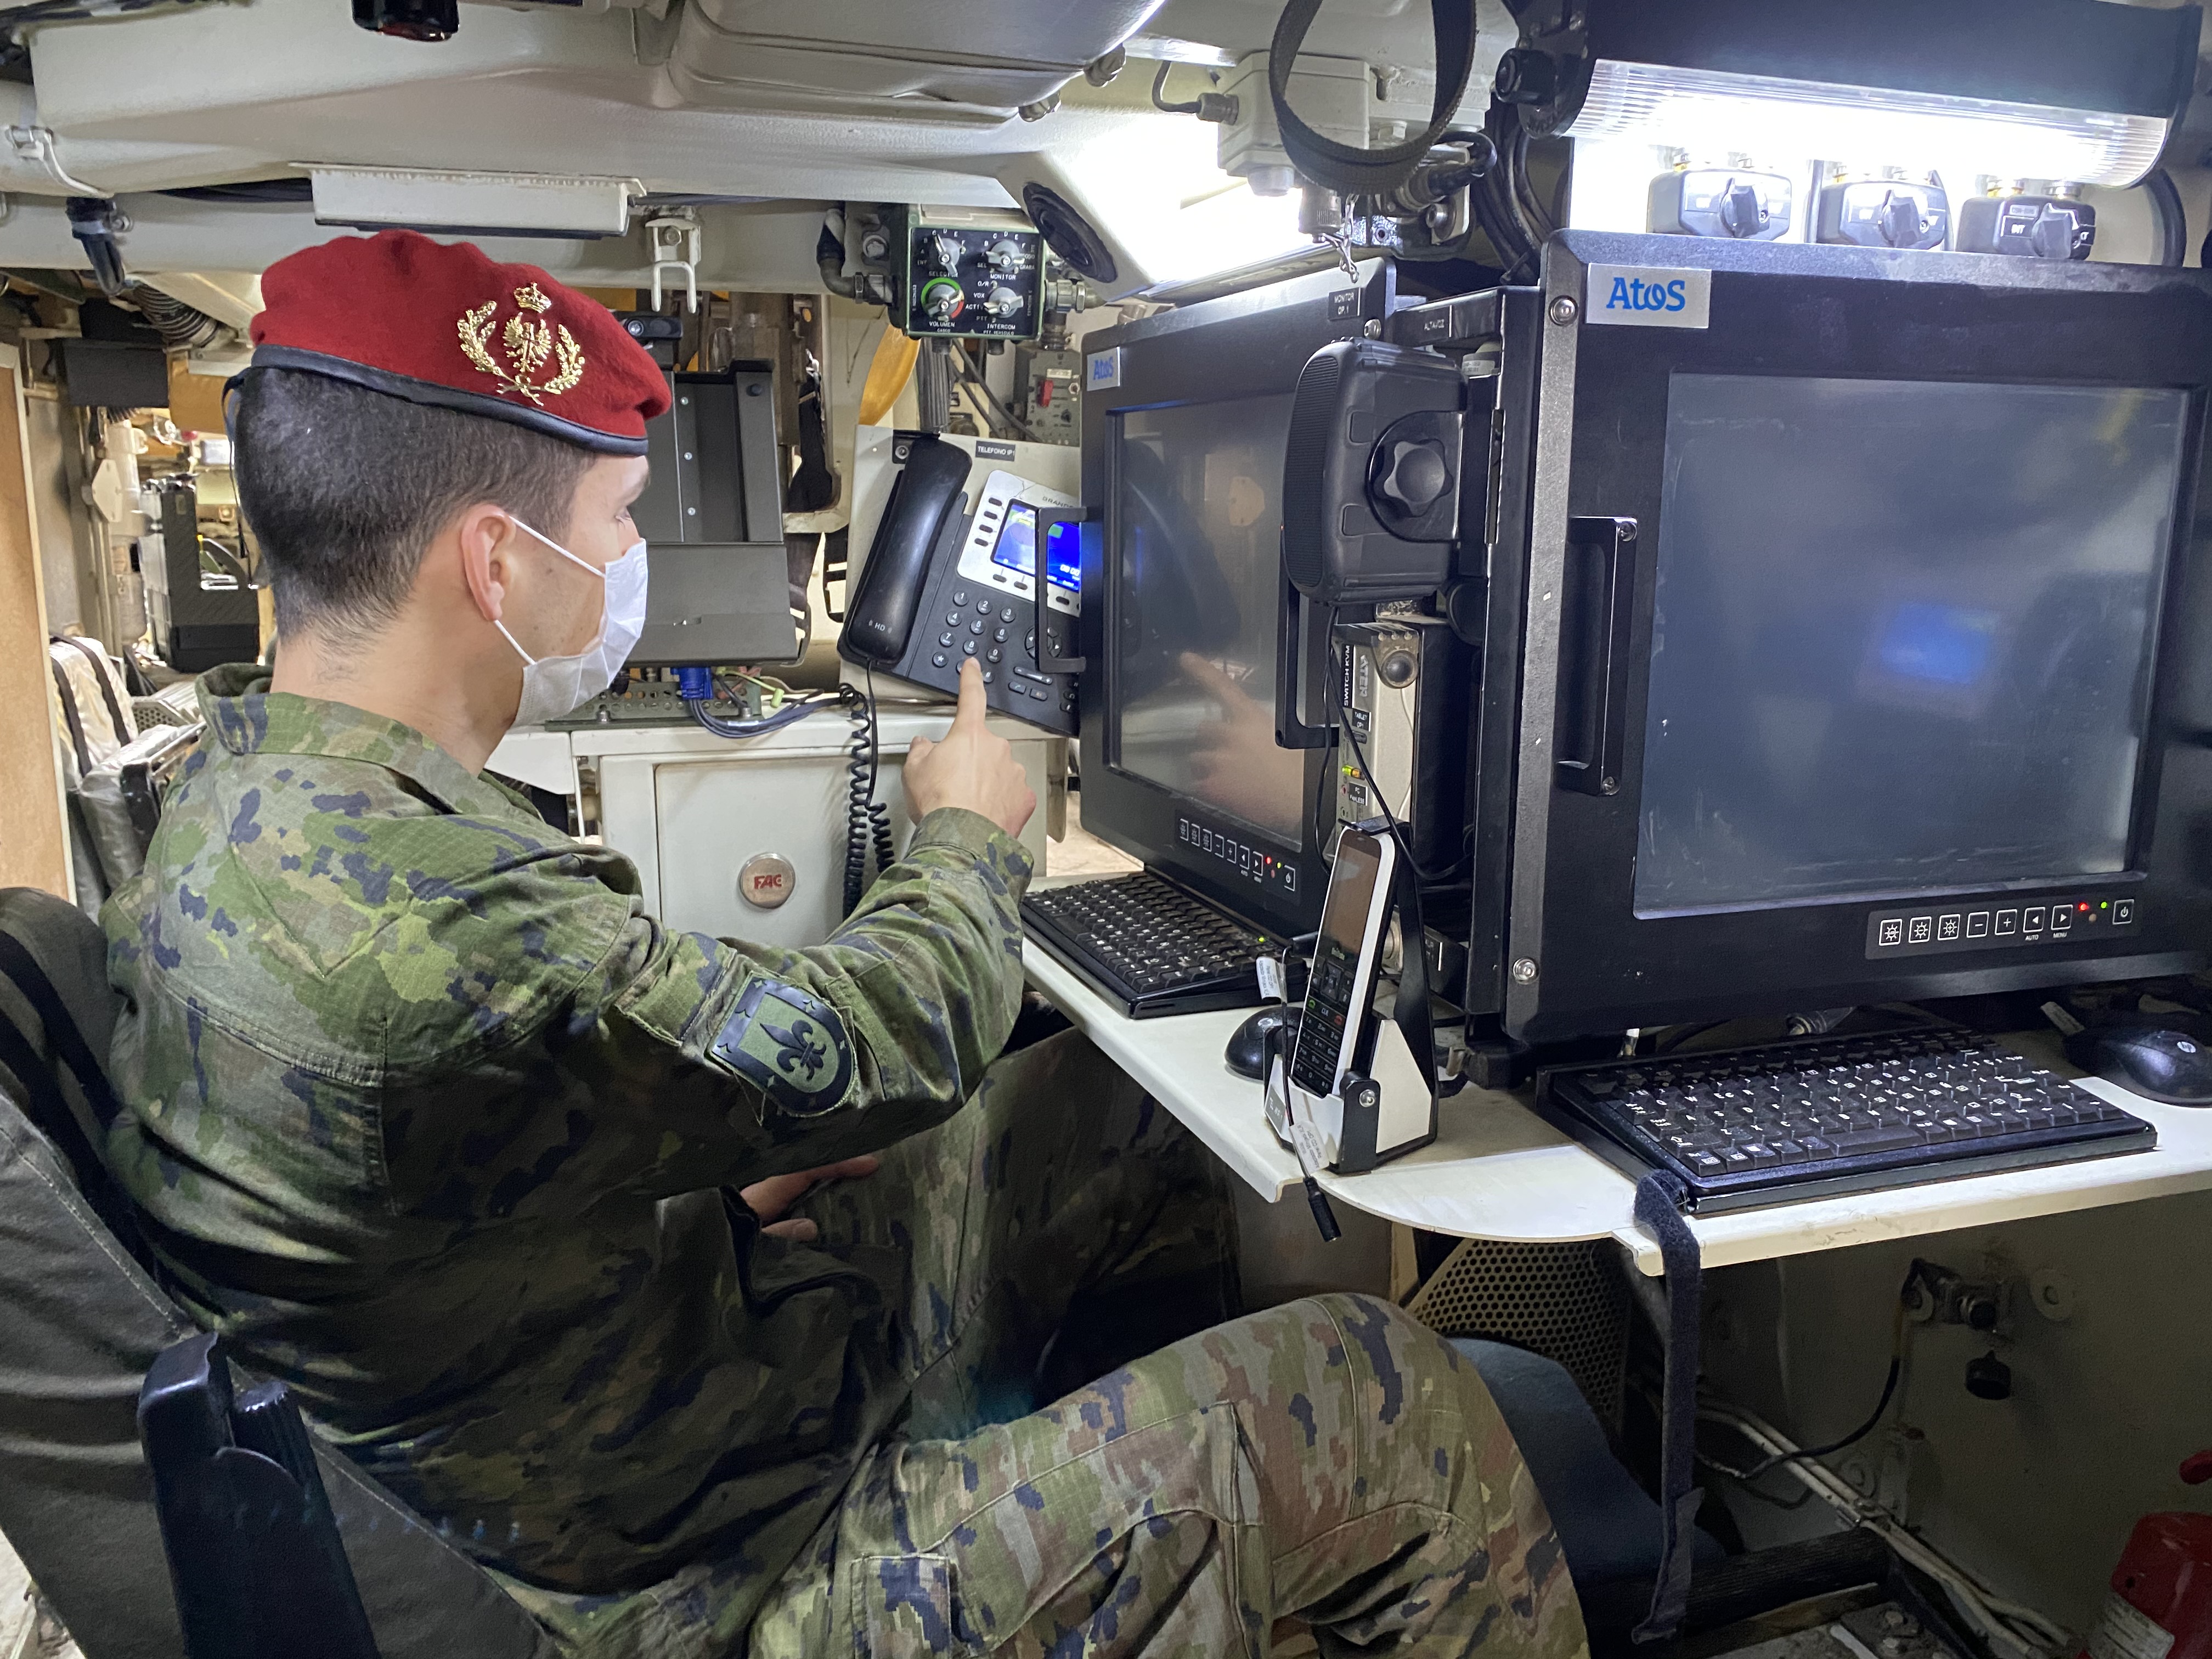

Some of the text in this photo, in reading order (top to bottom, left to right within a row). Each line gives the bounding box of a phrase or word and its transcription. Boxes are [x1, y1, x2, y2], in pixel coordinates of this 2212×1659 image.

[1334, 292, 1355, 303] MONITOR
[1606, 276, 1686, 312] Atos
[1093, 356, 1114, 380] Atos
[978, 445, 1007, 455] TELEFONO
[874, 622, 885, 631] HD
[1354, 711, 1368, 721] TABLET
[1349, 794, 1365, 805] FANLESS
[754, 873, 782, 890] FAC
